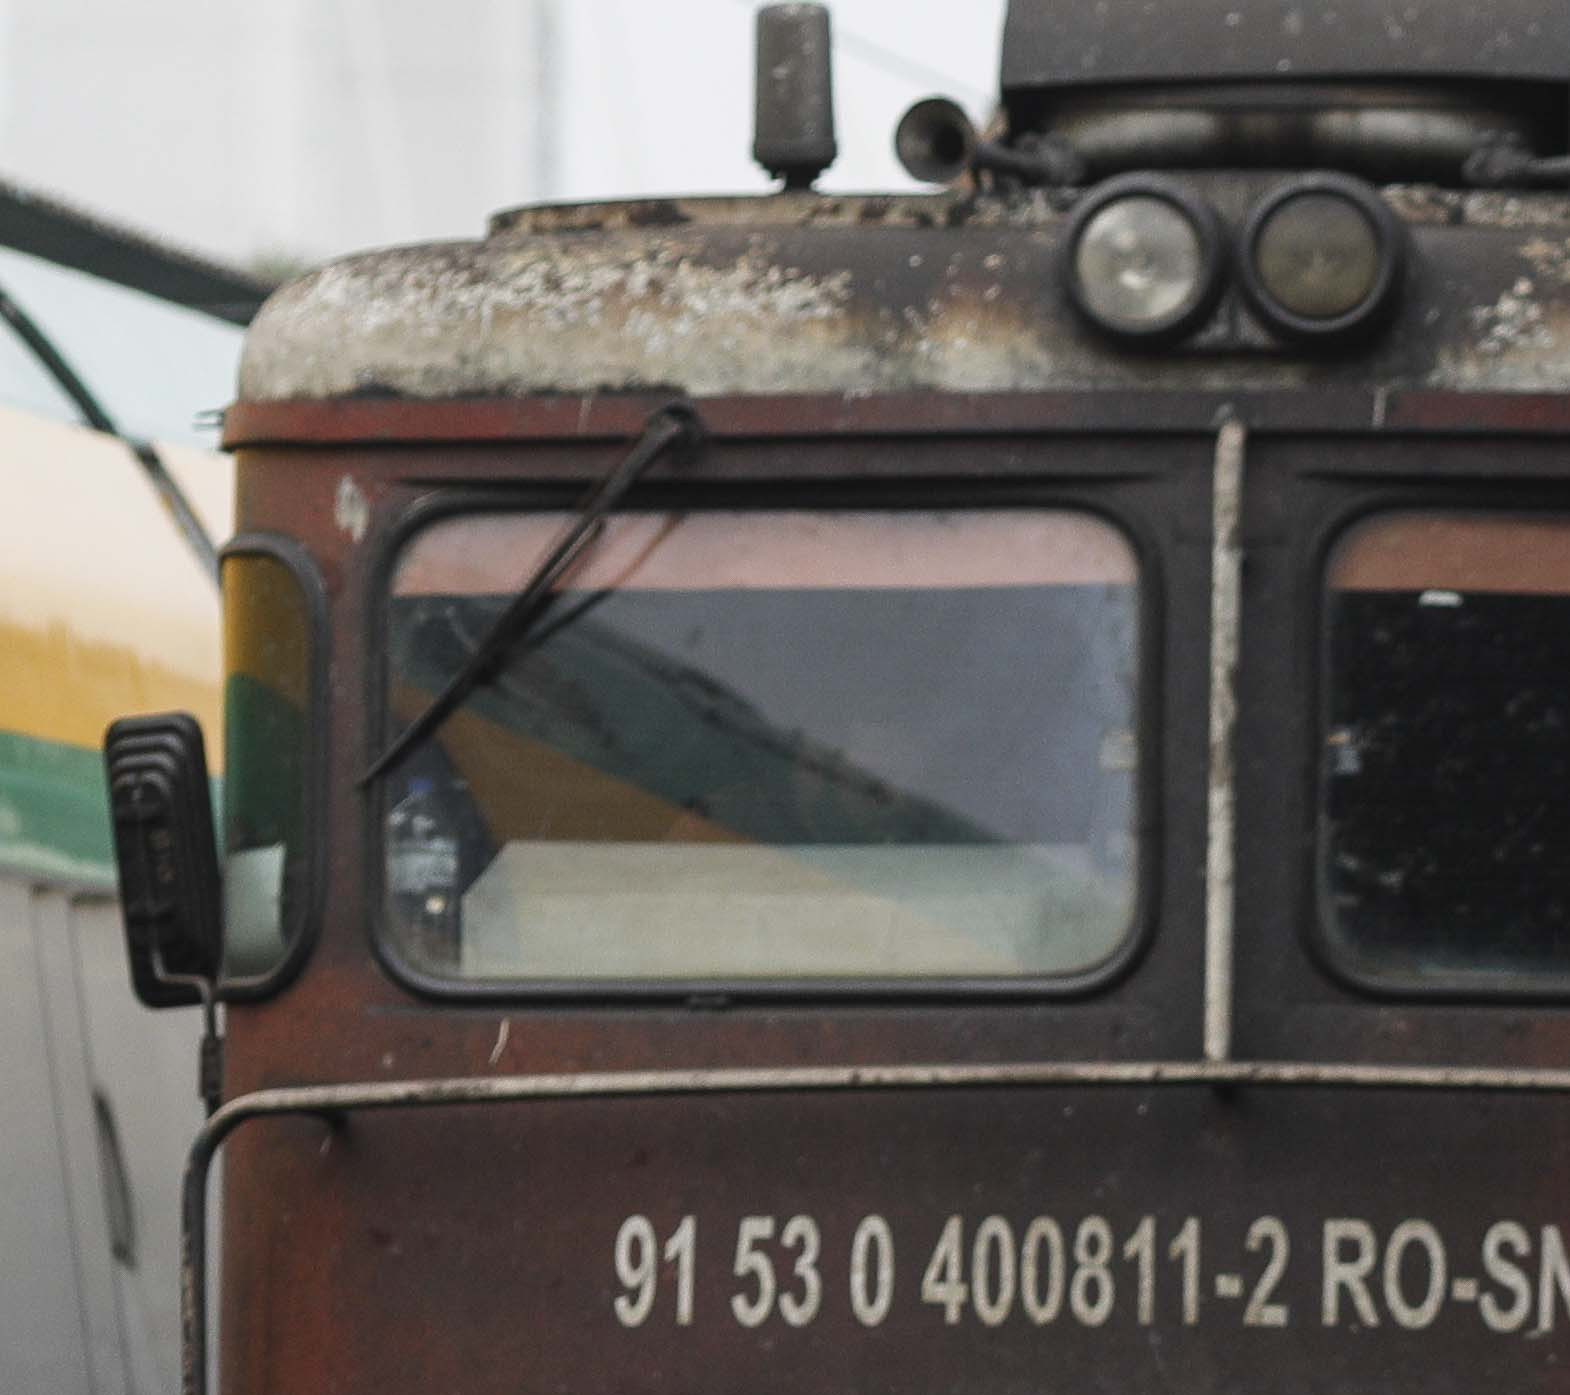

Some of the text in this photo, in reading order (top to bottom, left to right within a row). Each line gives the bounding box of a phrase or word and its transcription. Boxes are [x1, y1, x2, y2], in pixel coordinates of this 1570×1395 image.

[612, 1214, 697, 1327] 91
[730, 1214, 823, 1327] 53
[848, 1213, 895, 1328] 0
[920, 1215, 1290, 1327] 400811-2
